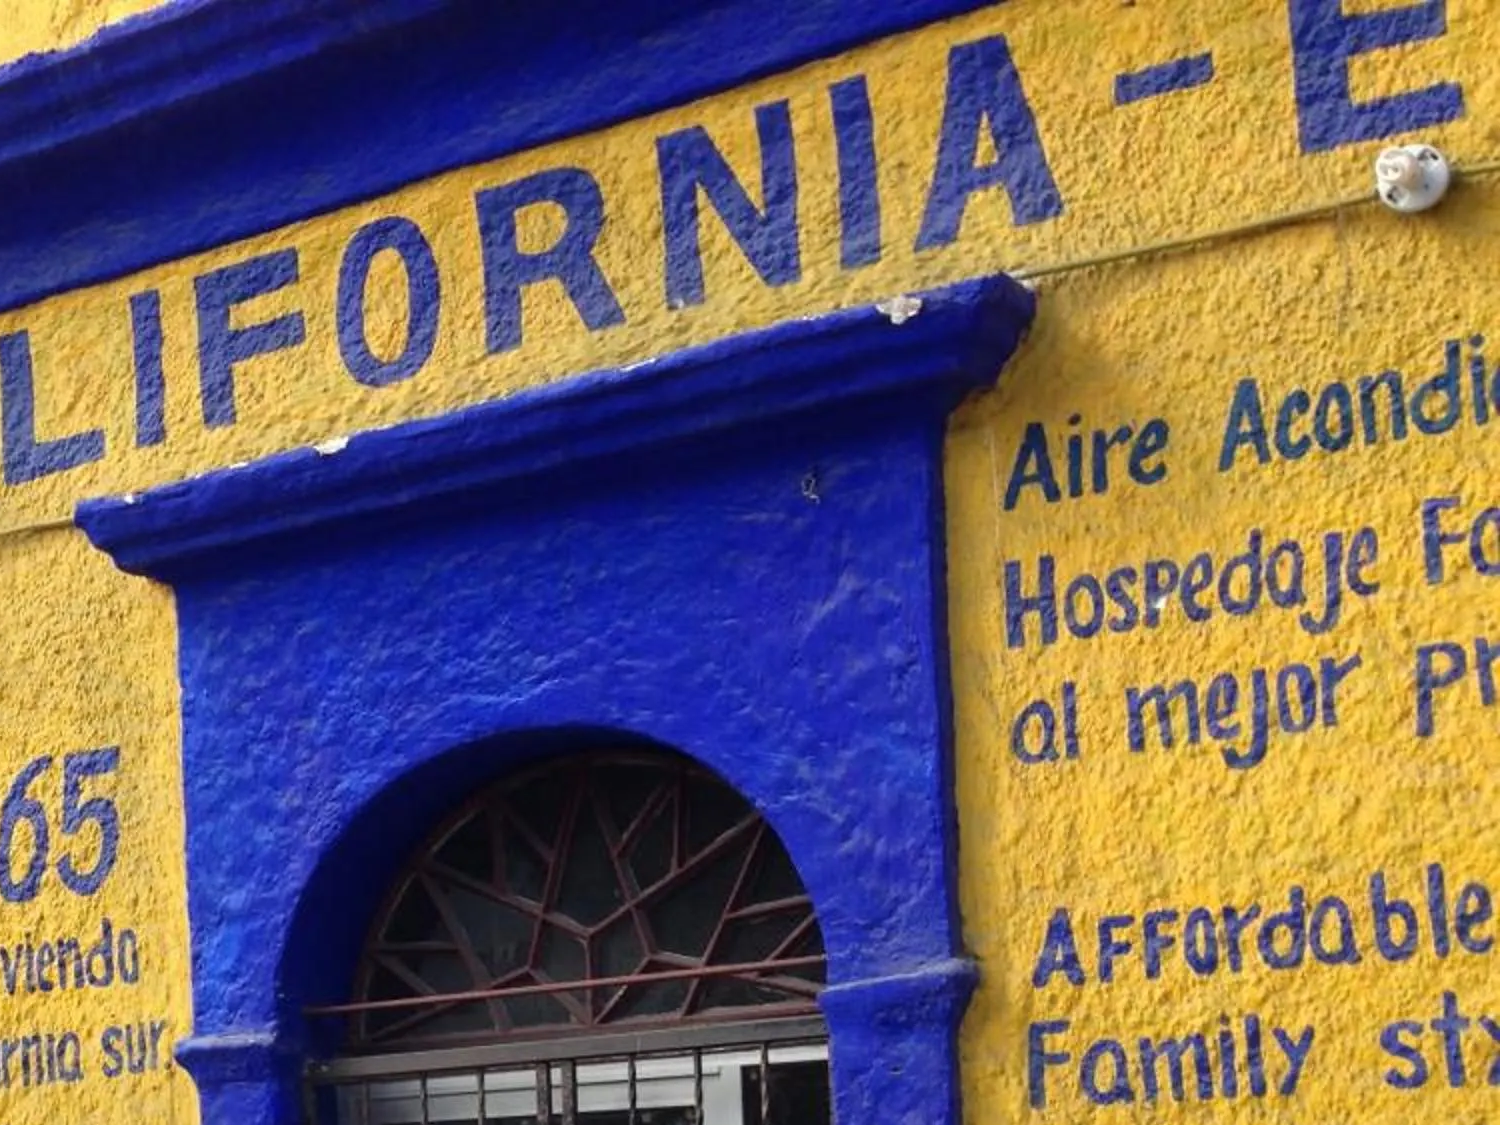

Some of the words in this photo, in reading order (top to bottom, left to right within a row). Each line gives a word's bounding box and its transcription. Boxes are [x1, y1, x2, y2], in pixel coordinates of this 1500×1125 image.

[1003, 413, 1170, 512] Aire
[1003, 525, 1381, 648] Hospedaje
[1010, 680, 1079, 765] al
[1125, 652, 1363, 769] mejor
[1027, 1012, 1316, 1110] Family
